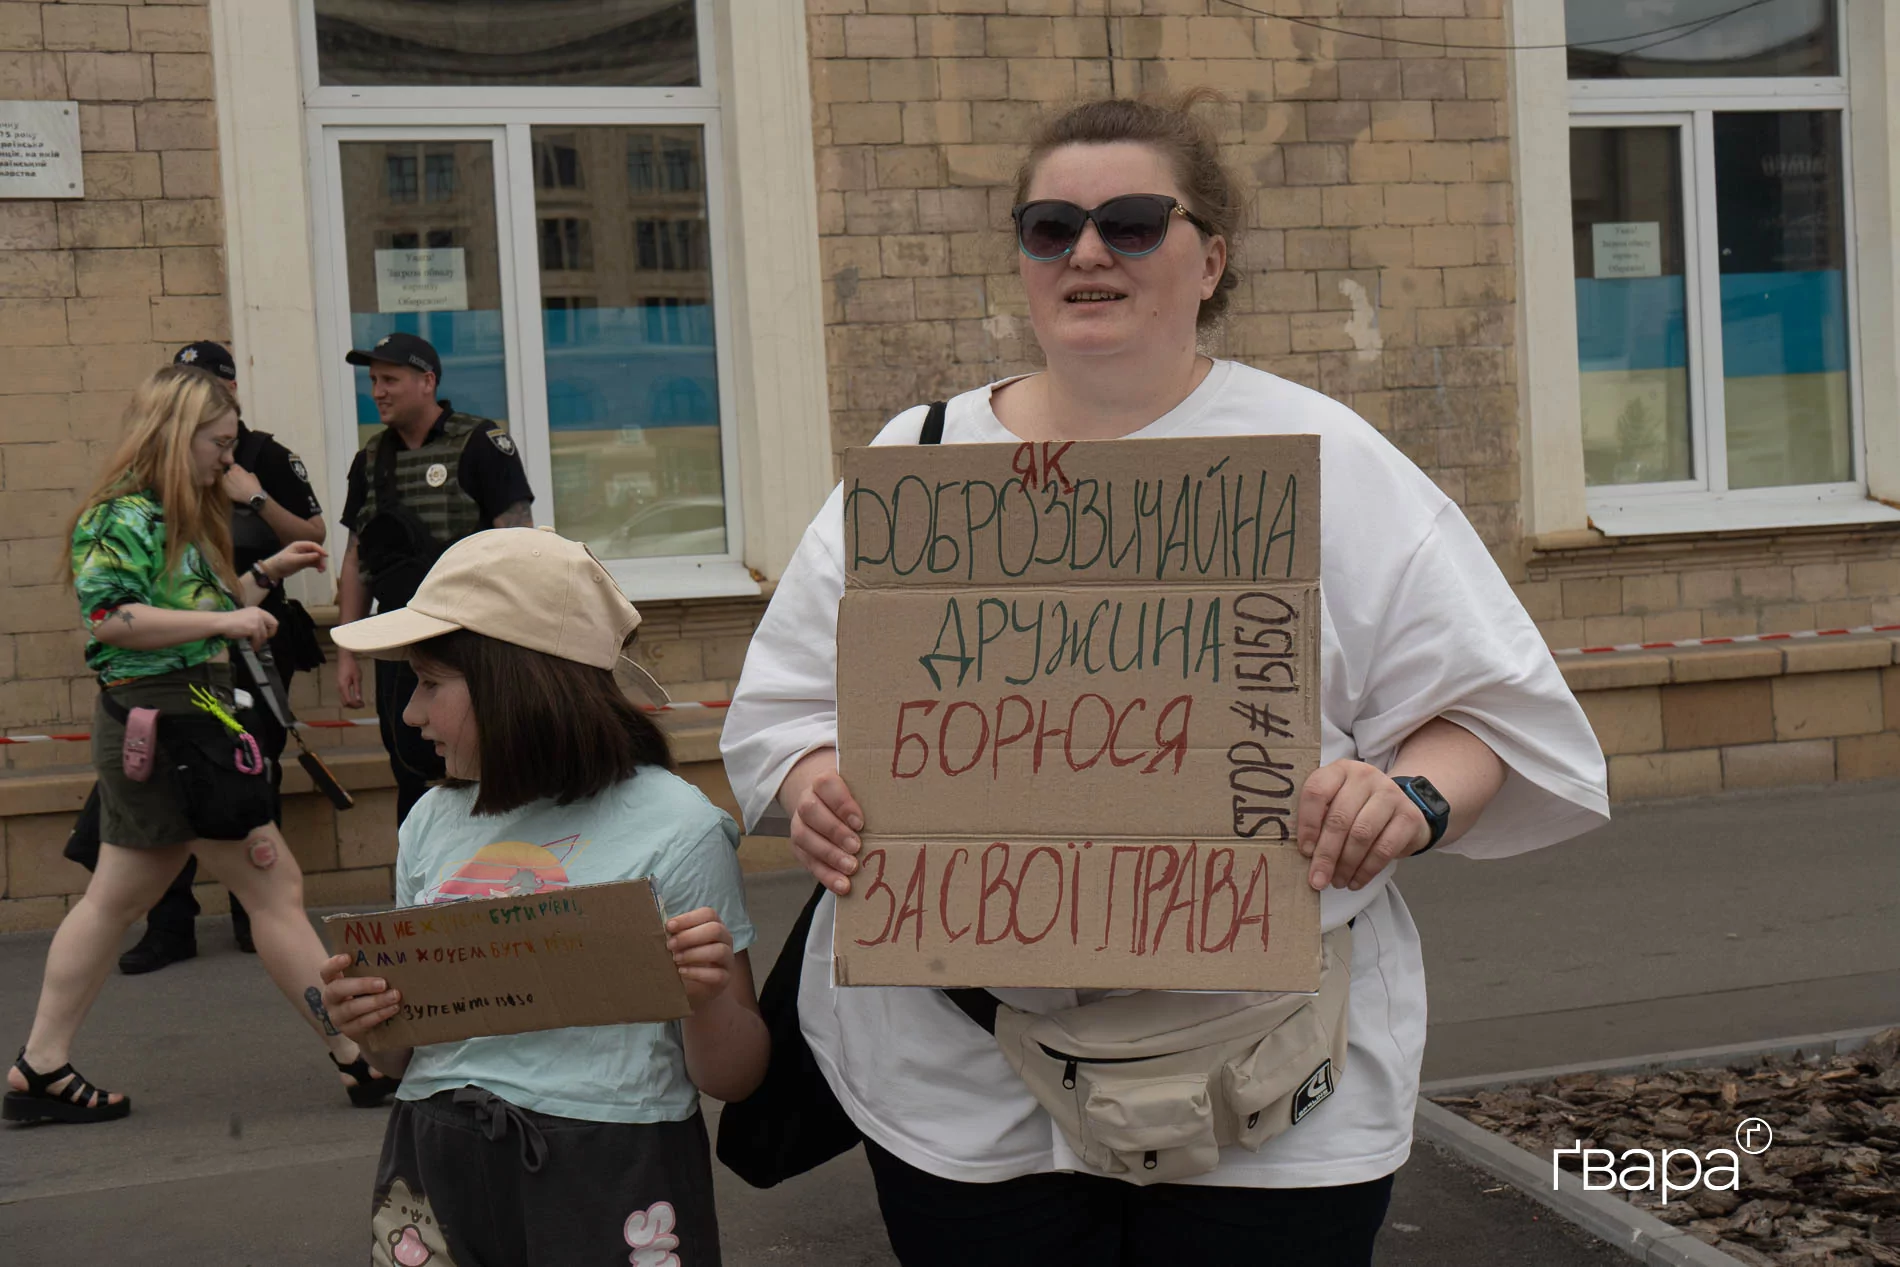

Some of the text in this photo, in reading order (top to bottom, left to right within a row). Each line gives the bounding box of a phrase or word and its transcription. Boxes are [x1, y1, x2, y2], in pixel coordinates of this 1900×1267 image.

[1011, 440, 1076, 495] ЯК
[918, 596, 1226, 690] ДРУЖИНА
[891, 693, 1194, 780] БОРЮСЯ
[1226, 741, 1295, 840] STOP
[344, 919, 387, 947] МИ
[489, 903, 537, 925] БУТИ
[854, 839, 1273, 956] ЗА СВОЇ ПРАВА
[354, 949, 371, 967] А
[376, 950, 408, 967] МИ
[416, 945, 487, 966] ХОЧЕМ
